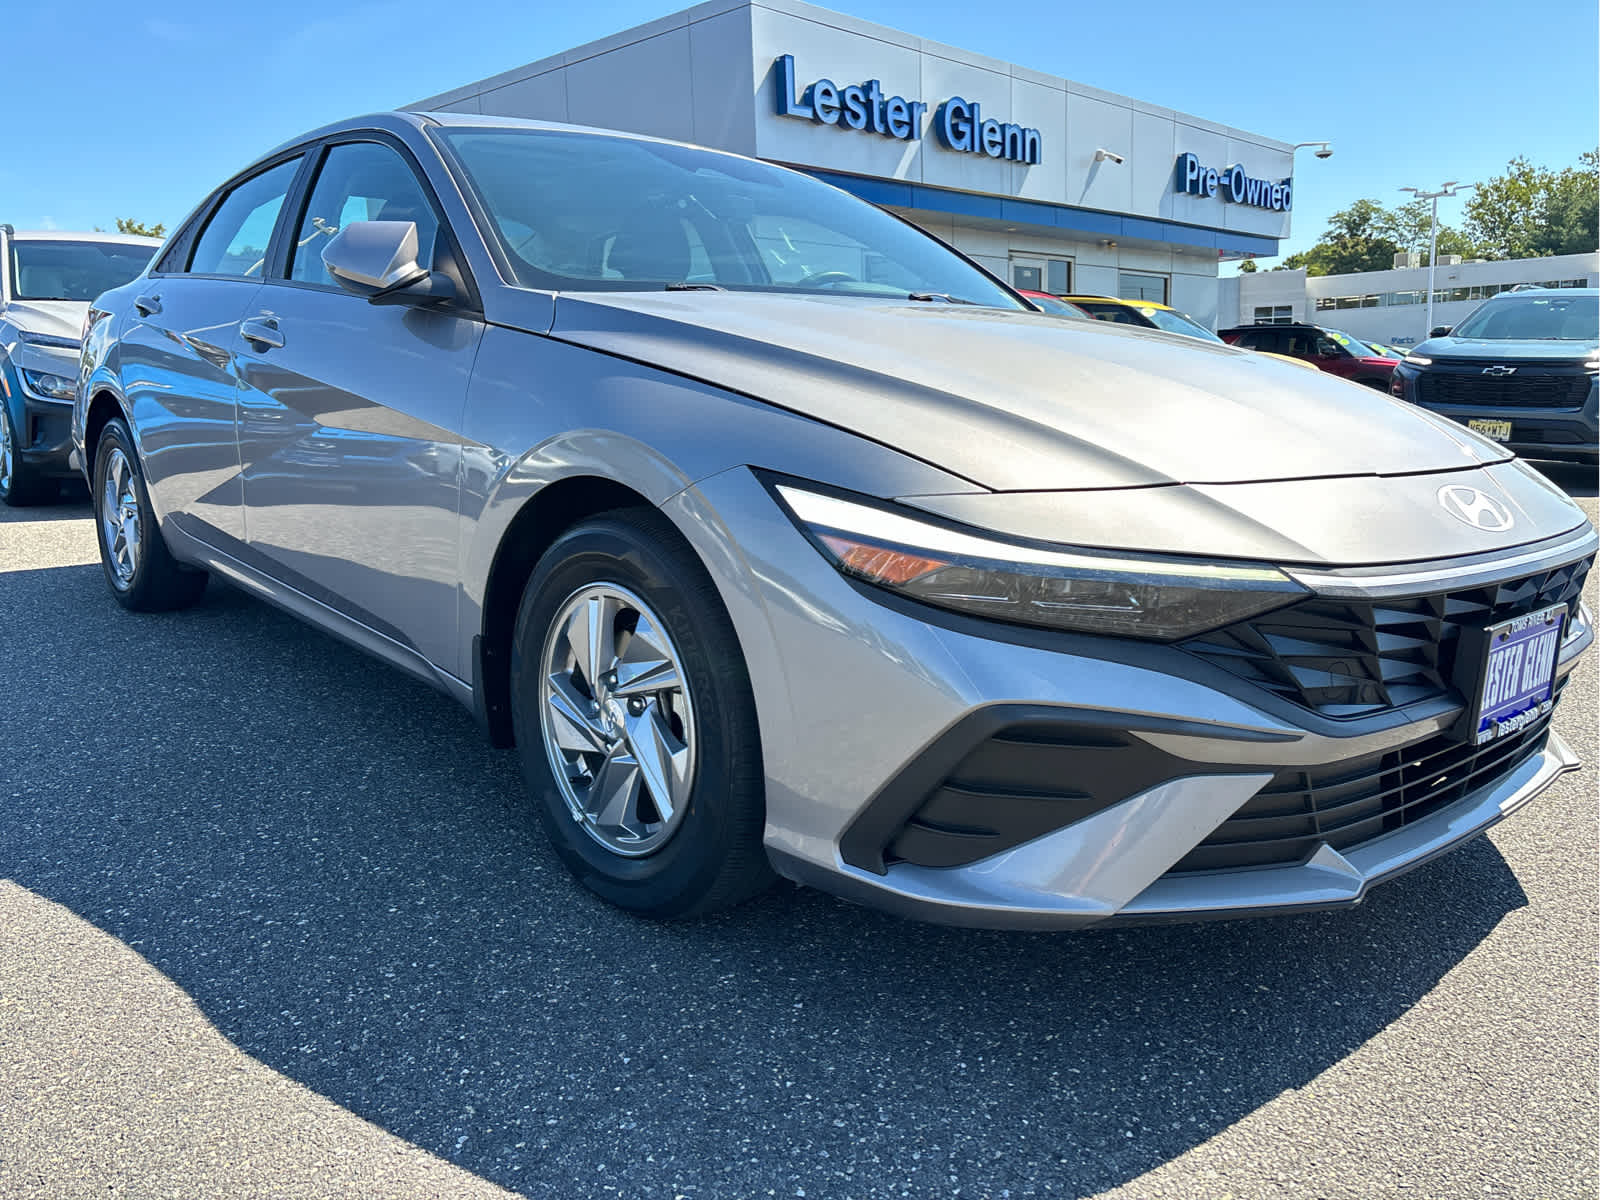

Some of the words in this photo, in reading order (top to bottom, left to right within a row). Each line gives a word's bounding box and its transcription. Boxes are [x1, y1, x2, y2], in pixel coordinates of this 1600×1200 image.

[776, 54, 927, 140] Lester
[935, 96, 1042, 164] Glenn
[1177, 152, 1292, 212] Pre-Owned
[1521, 630, 1558, 693] GLENN
